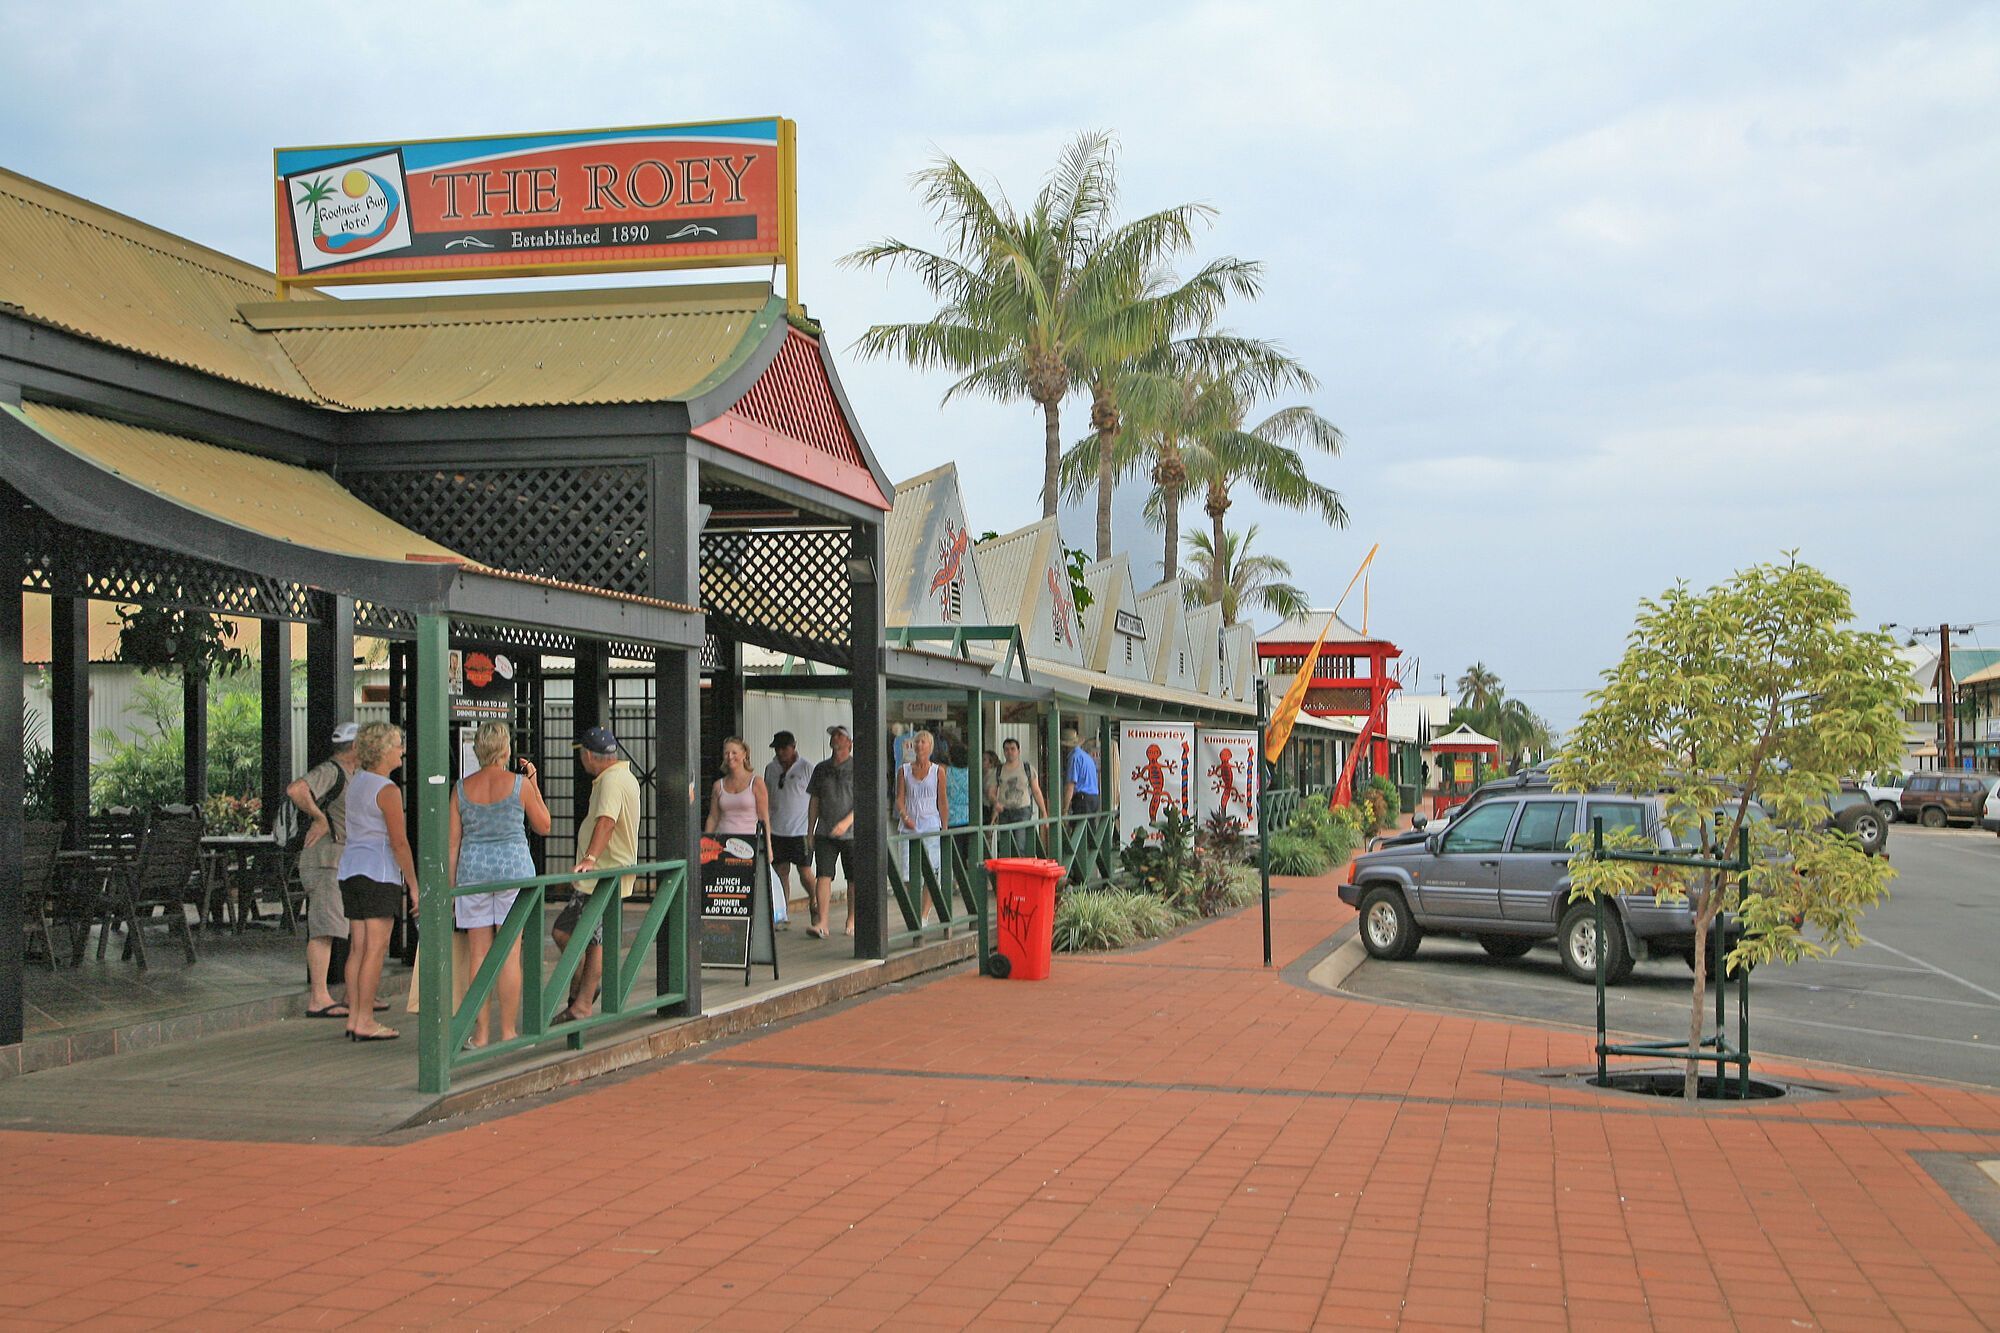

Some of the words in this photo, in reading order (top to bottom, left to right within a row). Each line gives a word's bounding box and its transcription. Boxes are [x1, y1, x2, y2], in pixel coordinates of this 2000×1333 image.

[430, 165, 562, 221] THE
[581, 154, 758, 212] ROEY
[319, 201, 361, 222] Roebuck
[365, 194, 387, 211] Bay
[341, 213, 370, 233] Hotel
[511, 227, 600, 248] Established
[612, 224, 650, 244] 1890
[456, 698, 474, 707] LUNCH
[456, 709, 477, 718] DINNER
[1127, 728, 1187, 741] Kimberley
[1203, 735, 1252, 747] Kimberley
[716, 877, 741, 886] LUNCH
[705, 885, 723, 893] 12.00
[724, 885, 735, 893] TO
[735, 885, 751, 894] 2.00
[713, 898, 741, 907] DINNER
[705, 906, 720, 914] 6.00
[721, 906, 732, 914] TO
[732, 906, 748, 915] 9.00
